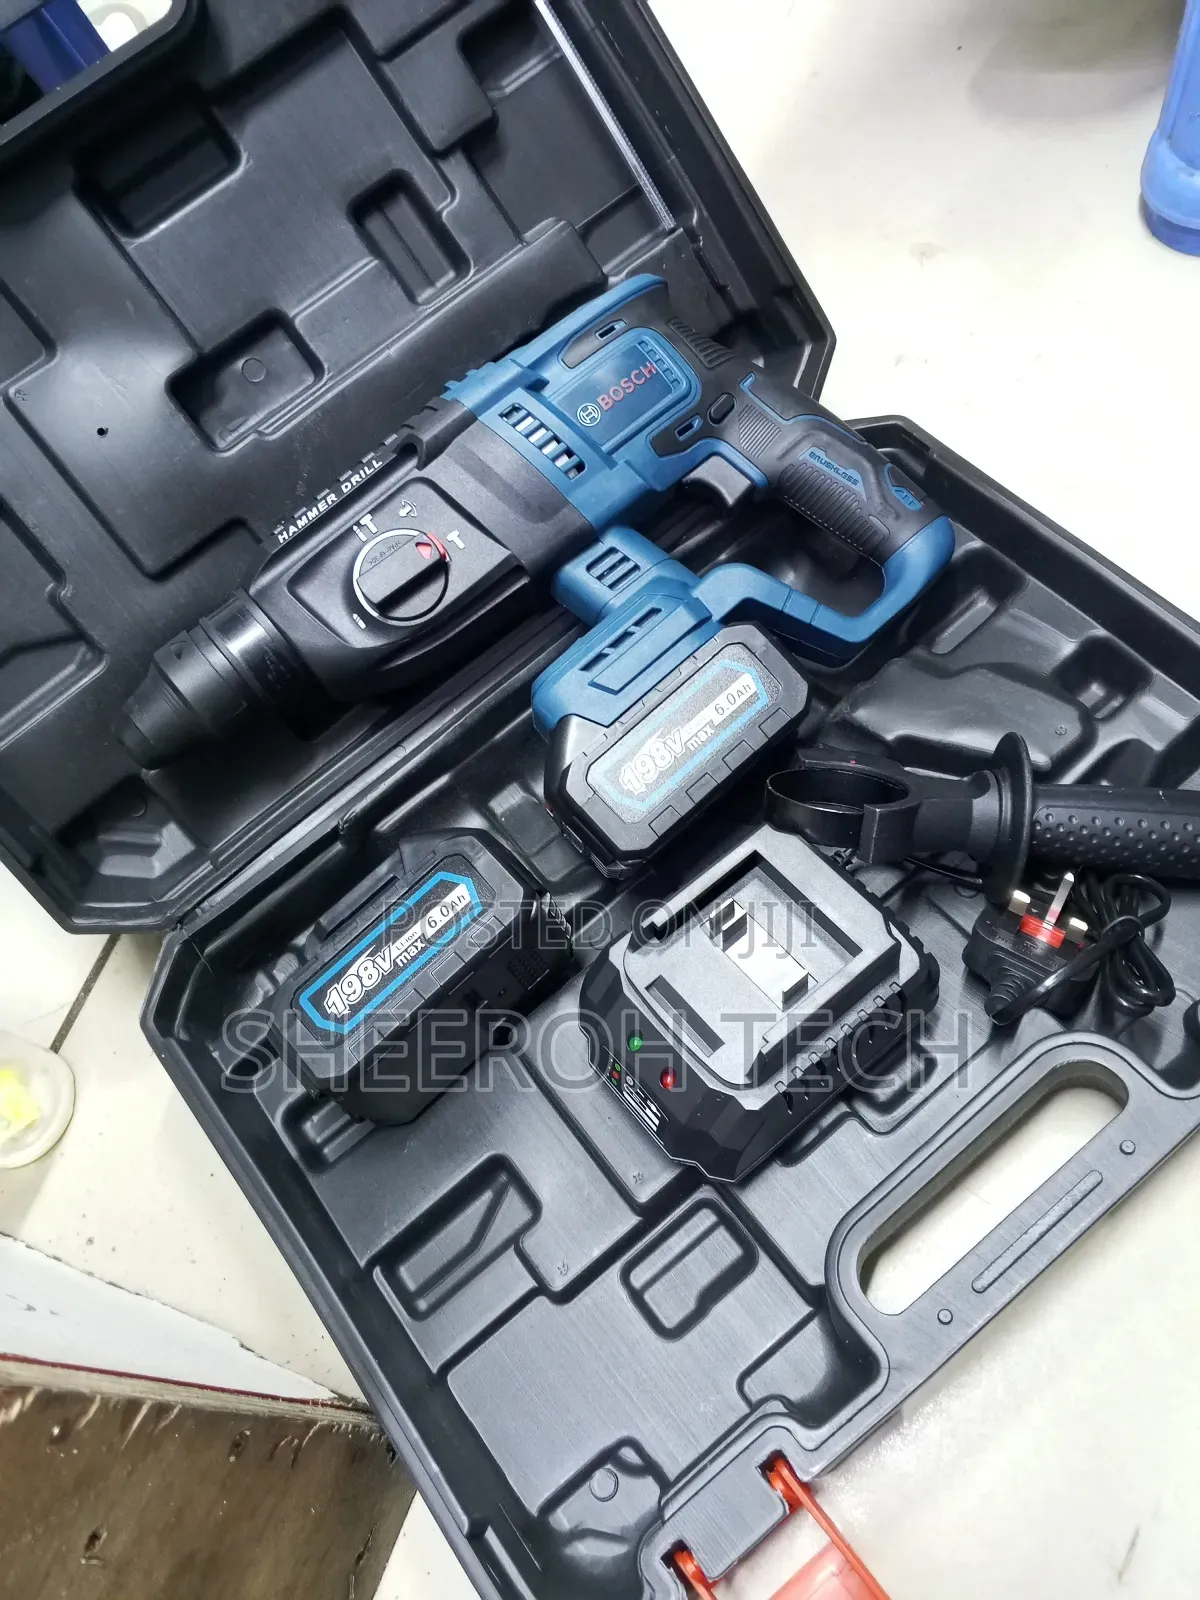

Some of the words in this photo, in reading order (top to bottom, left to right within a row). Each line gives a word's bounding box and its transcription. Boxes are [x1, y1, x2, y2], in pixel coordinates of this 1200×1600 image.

[597, 361, 657, 411] BOSCH
[277, 493, 338, 544] HAMMER
[340, 458, 383, 492] DRILL
[619, 725, 683, 795] 198V
[714, 682, 752, 716] 6.0Ah
[687, 725, 716, 751] max
[323, 941, 395, 1018] 198V
[427, 893, 466, 929] 6.0Ah
[395, 939, 426, 967] max
